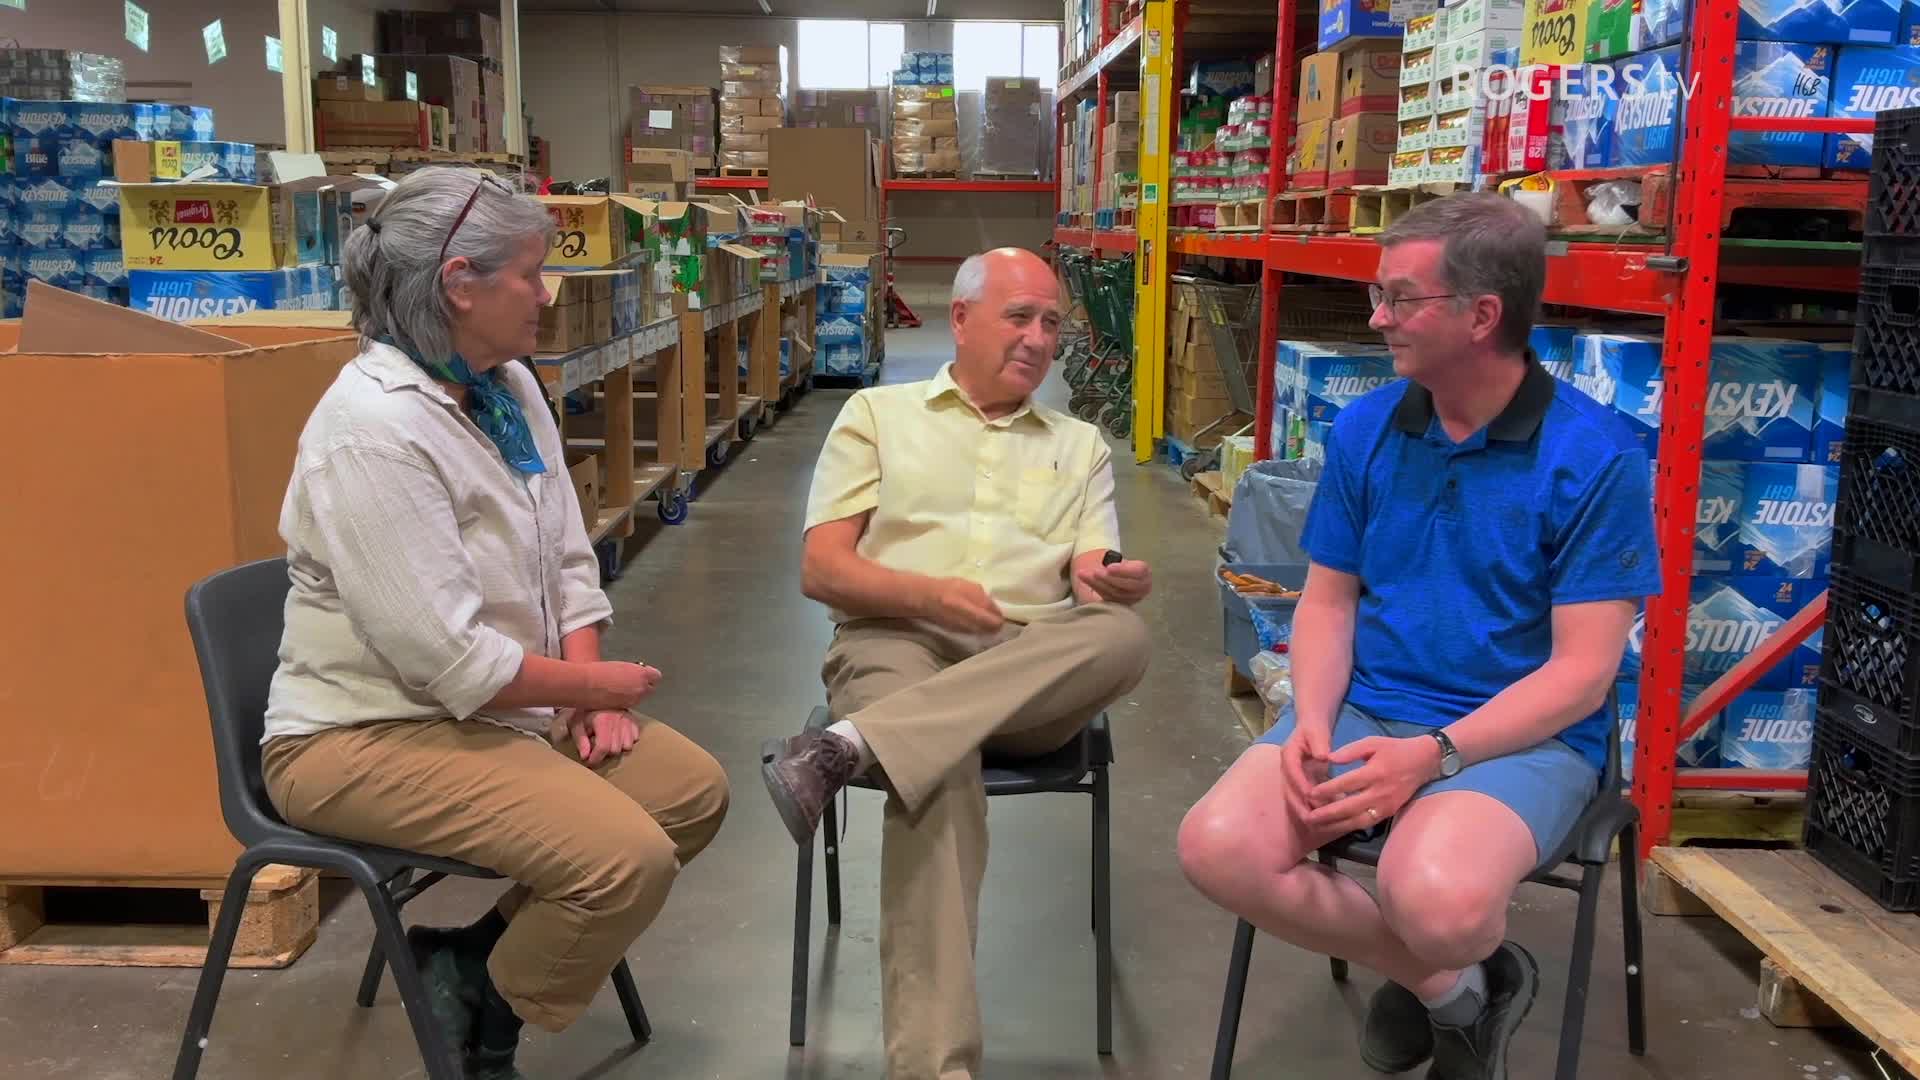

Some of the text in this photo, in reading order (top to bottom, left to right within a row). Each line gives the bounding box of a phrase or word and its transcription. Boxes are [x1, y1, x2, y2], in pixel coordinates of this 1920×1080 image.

[1531, 13, 1577, 57] Coors
[1859, 68, 1904, 86] LIGHT
[1732, 96, 1819, 118] YSTONE
[1845, 84, 1920, 112] STONE
[17, 111, 67, 128] KEYSTONE
[80, 112, 129, 128] KEYSTONE
[1614, 87, 1678, 135] KEYSTONE
[25, 153, 48, 164] Blue
[176, 203, 209, 221] Original
[148, 227, 244, 260] Coors
[29, 258, 77, 273] KEYSTONE
[149, 256, 164, 265] 24
[150, 281, 193, 296] LIGHT
[146, 296, 257, 320] KEYSTONE
[1328, 363, 1361, 377] LIGHT
[1751, 500, 1837, 528] YSTONE
[1778, 582, 1793, 593] 24
[1684, 619, 1779, 652] STONE
[1738, 718, 1811, 743] STONE
